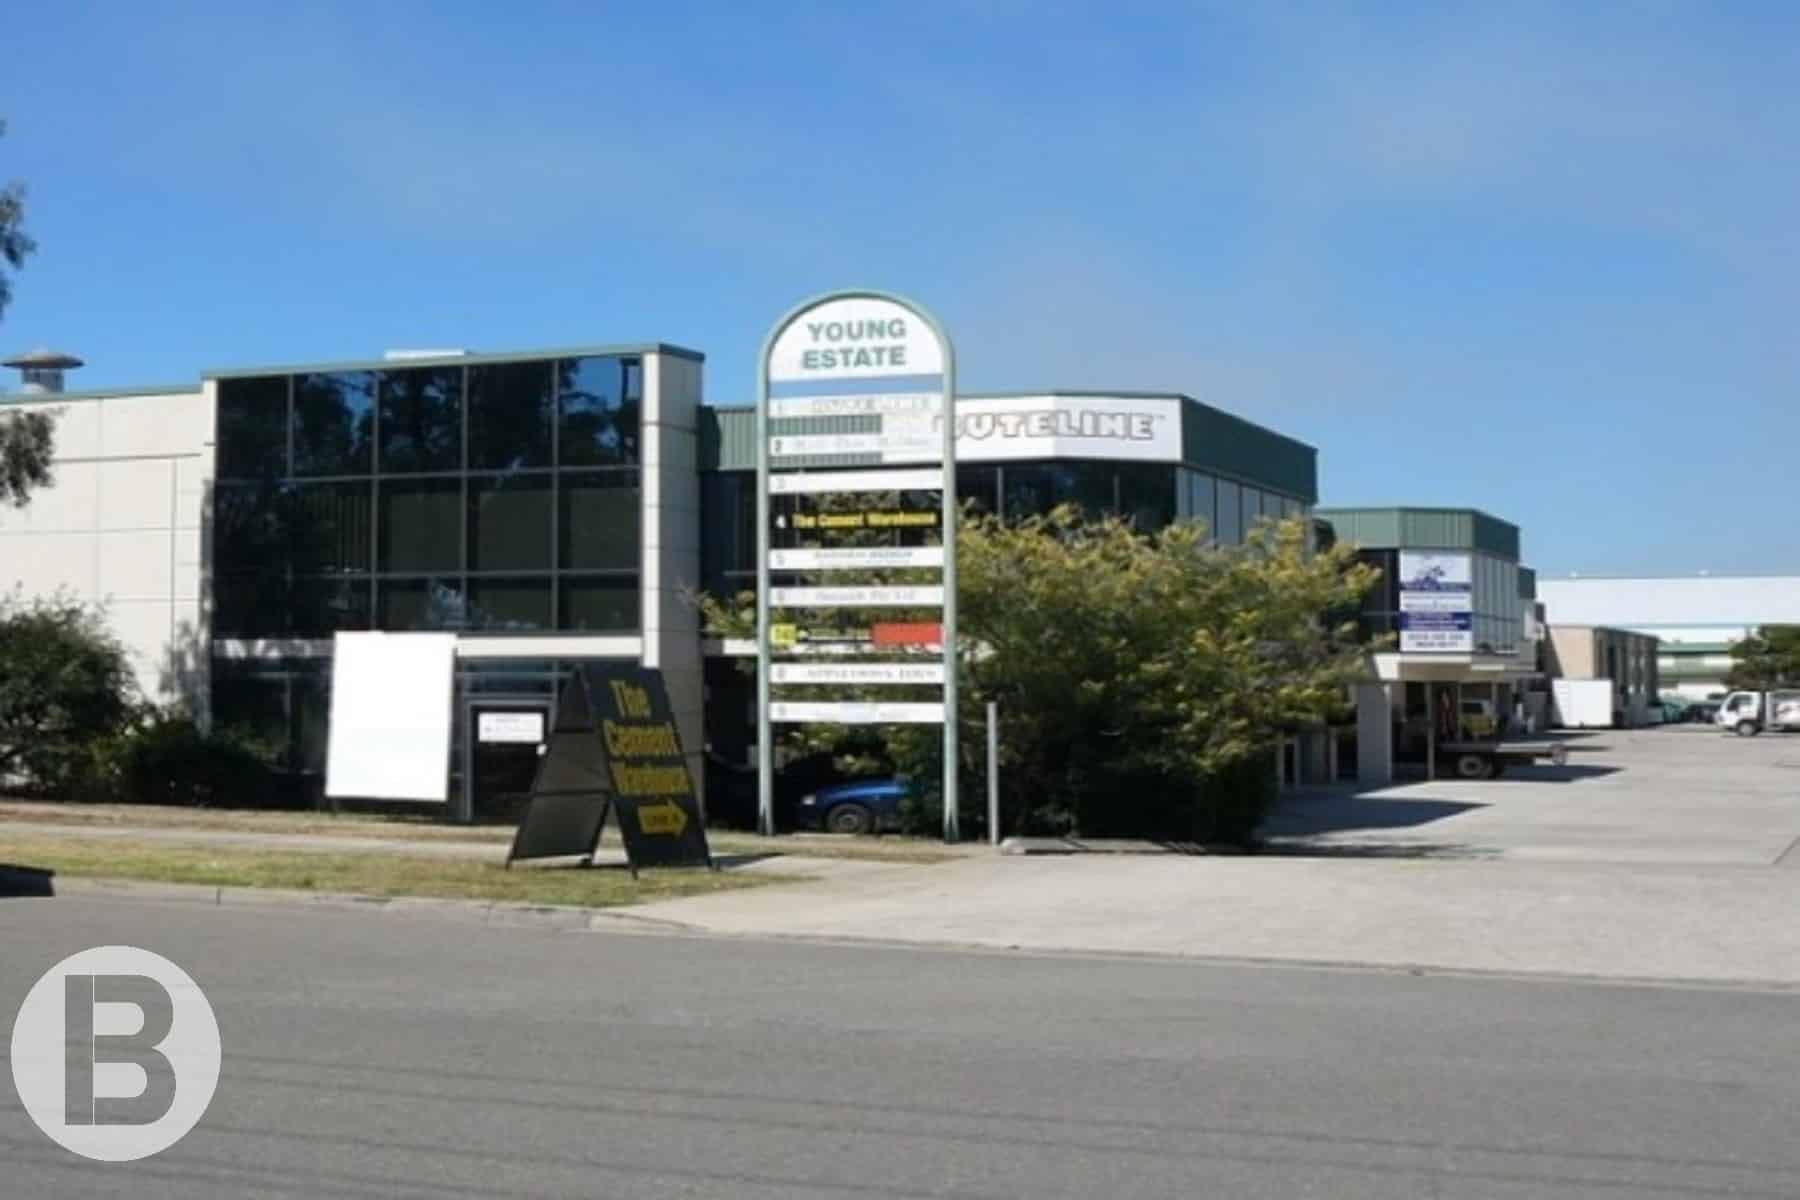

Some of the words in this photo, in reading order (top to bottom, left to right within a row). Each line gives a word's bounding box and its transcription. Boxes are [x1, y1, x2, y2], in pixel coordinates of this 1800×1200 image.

[807, 318, 907, 342] YOUNG
[801, 346, 907, 370] ESTATE
[610, 680, 652, 719] The
